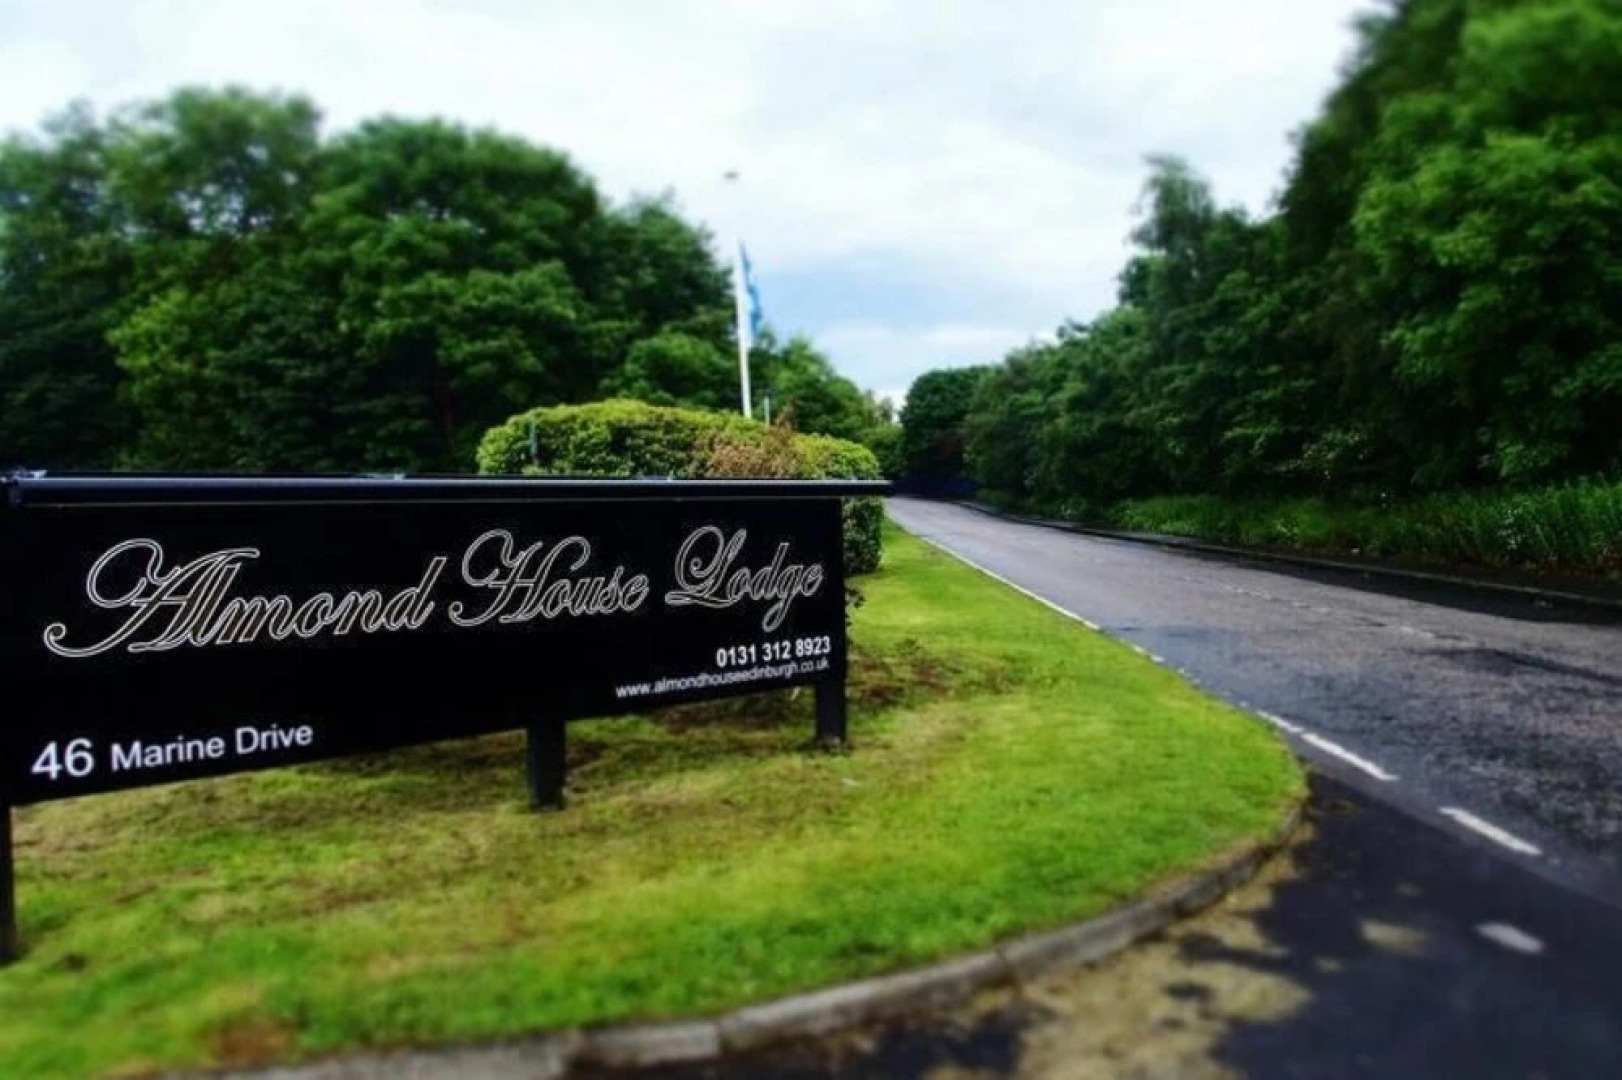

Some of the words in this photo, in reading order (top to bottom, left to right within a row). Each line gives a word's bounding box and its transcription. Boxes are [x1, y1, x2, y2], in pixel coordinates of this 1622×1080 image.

[43, 538, 447, 658] Almond
[448, 528, 650, 627] House
[664, 525, 825, 632] Lodge
[716, 644, 757, 668] 0131
[762, 640, 791, 662] 312
[796, 635, 831, 658] 8923
[615, 656, 830, 698] www.almondhouseedinburgh.co.uk
[31, 738, 95, 780] 46
[111, 735, 225, 772] Marine
[235, 724, 314, 755] Drive
